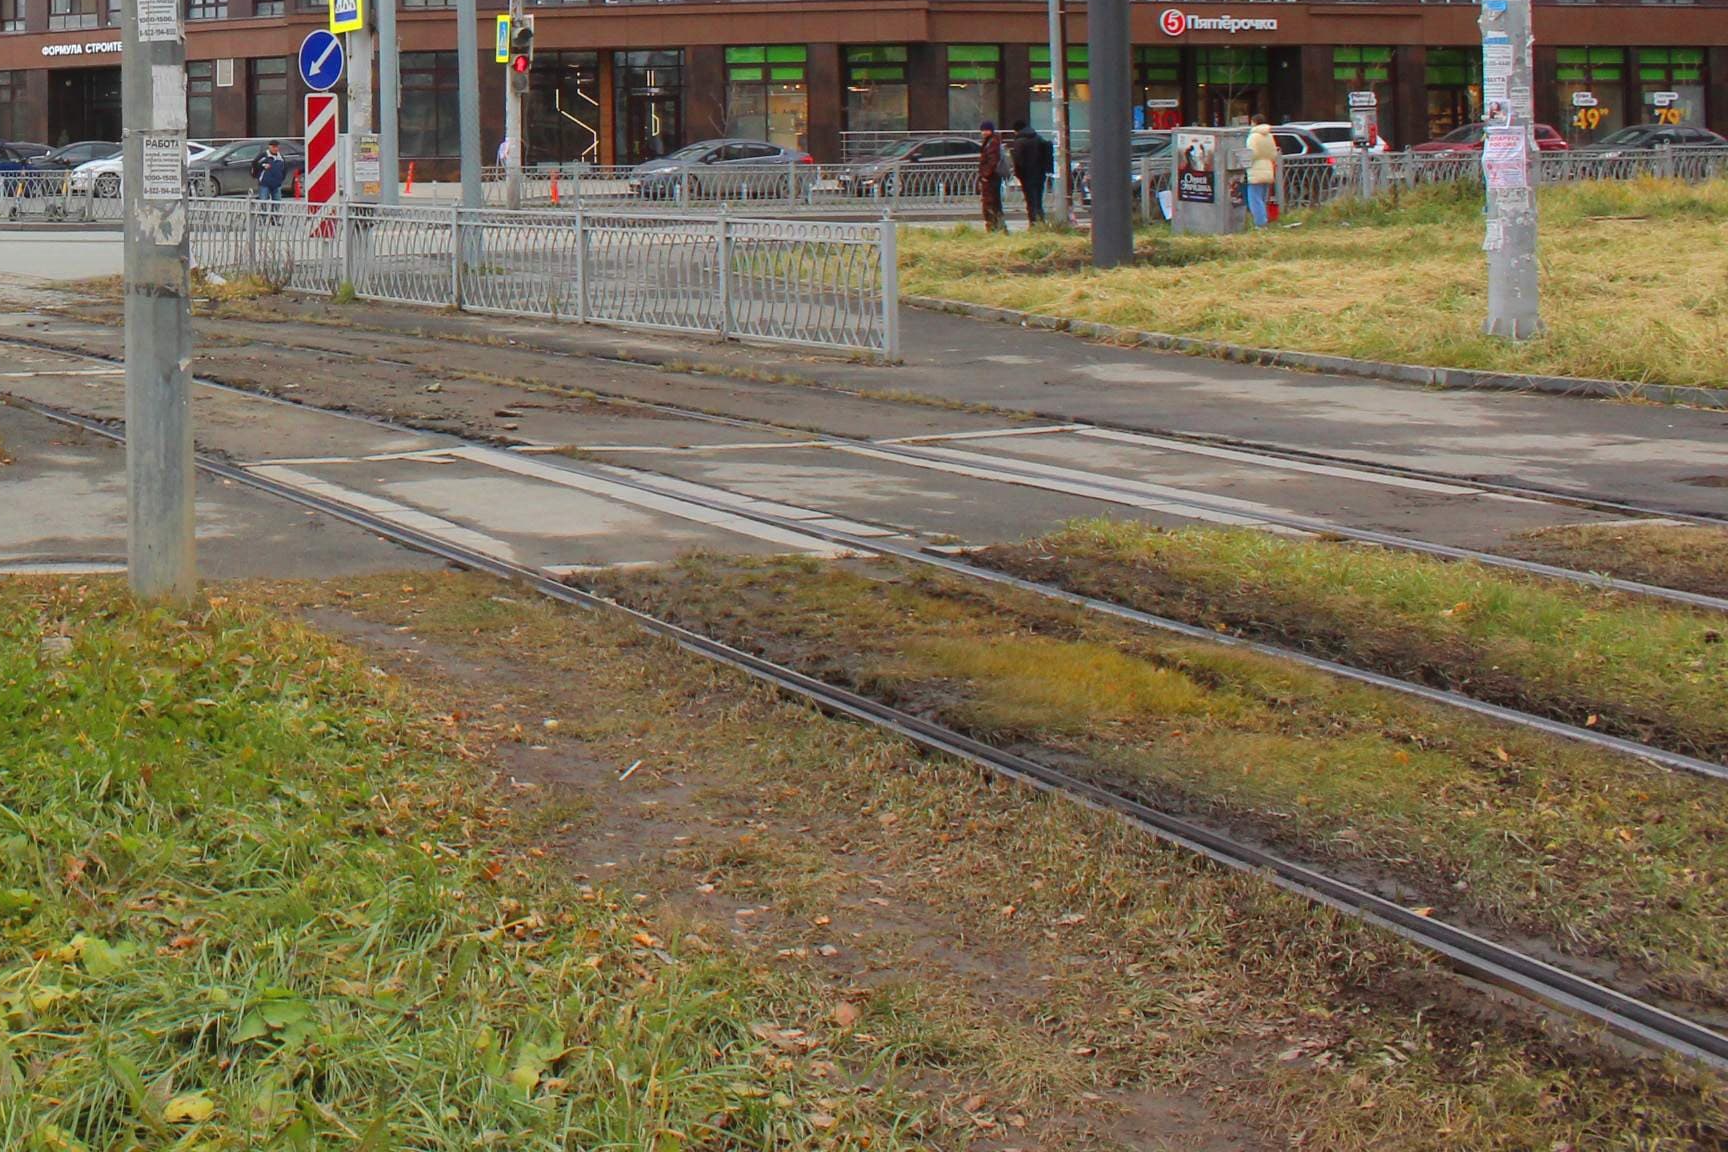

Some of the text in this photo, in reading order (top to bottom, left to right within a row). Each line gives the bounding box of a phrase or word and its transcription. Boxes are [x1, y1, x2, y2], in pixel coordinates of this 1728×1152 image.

[1187, 14, 1277, 34] Пятёрочка
[42, 44, 83, 56] ФОРМУЛА
[145, 139, 178, 147] РАБОТА
